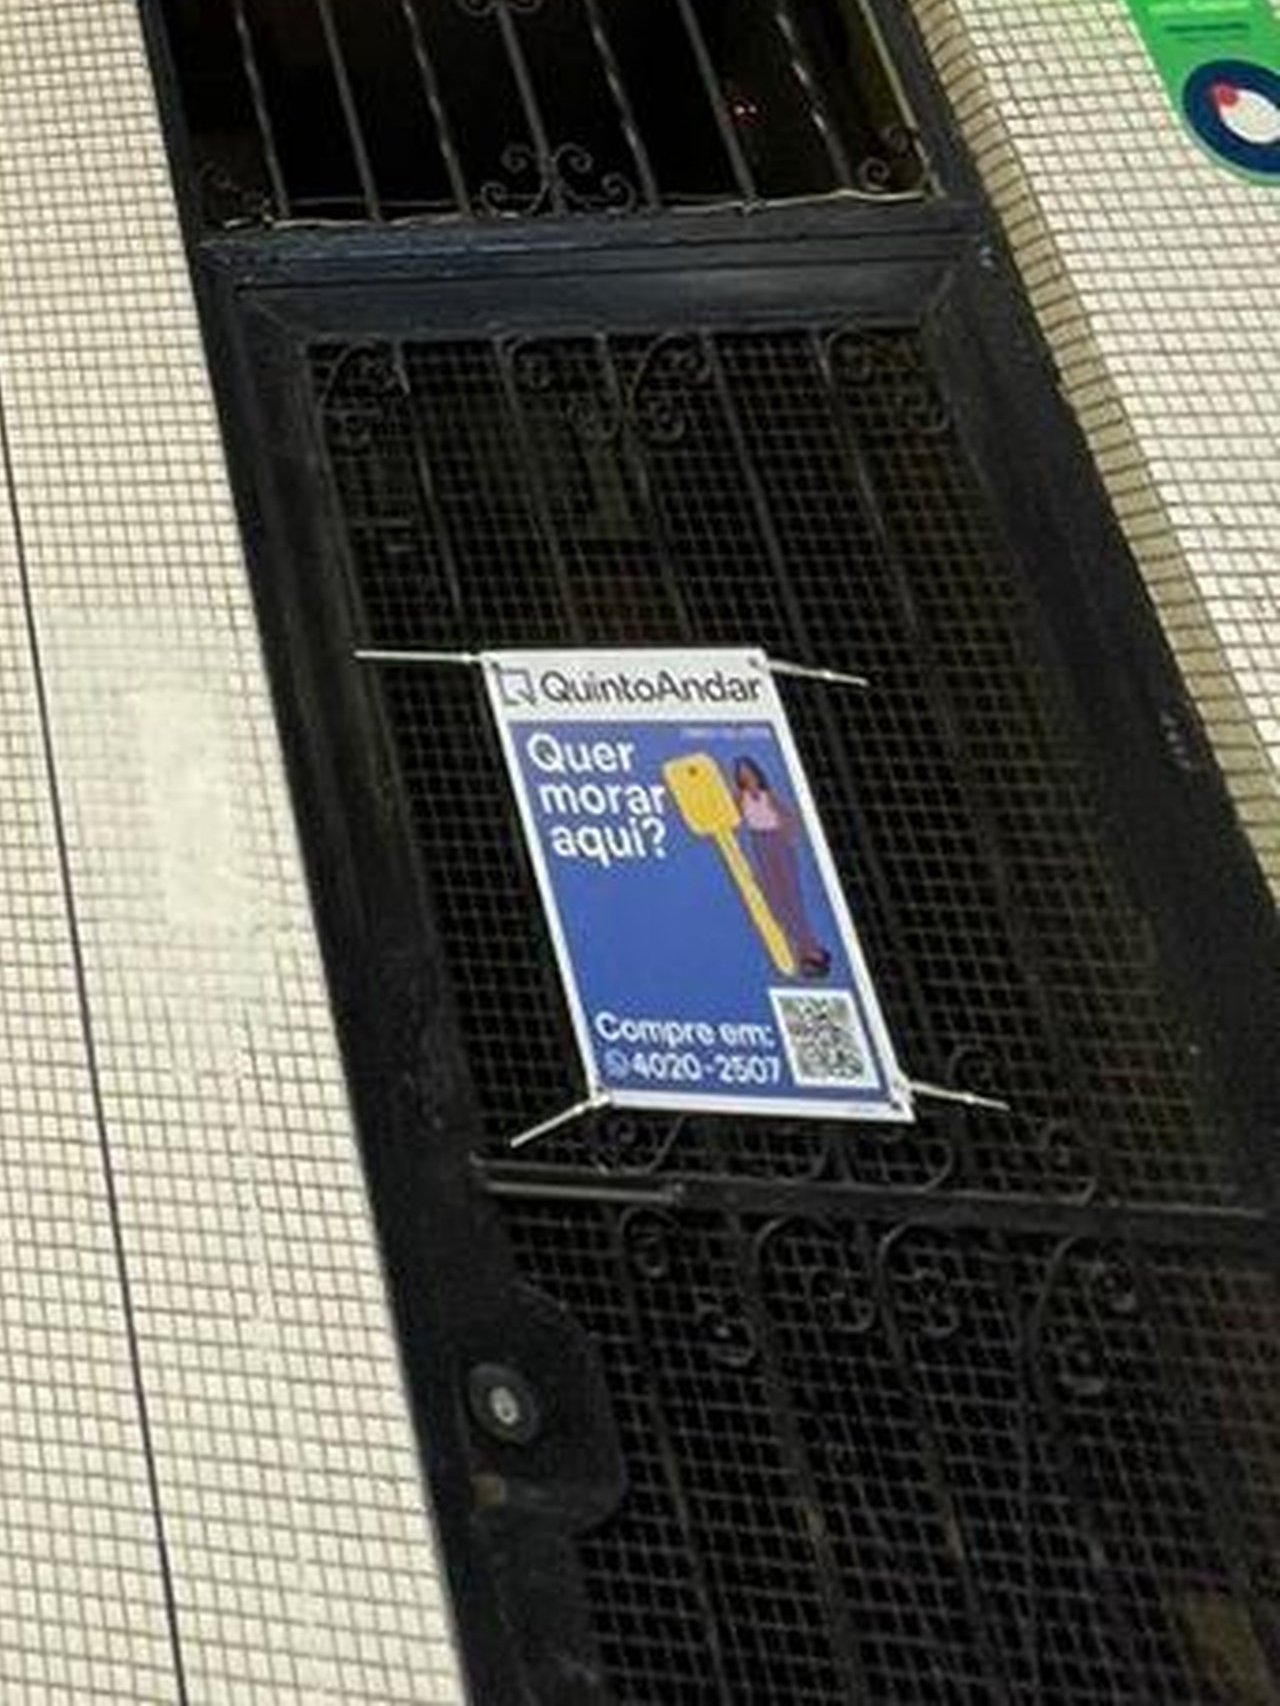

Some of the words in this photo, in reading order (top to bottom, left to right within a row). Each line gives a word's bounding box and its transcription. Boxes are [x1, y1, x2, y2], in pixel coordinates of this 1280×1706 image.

[539, 669, 763, 703] QuintoAndar
[526, 732, 635, 775] Quer
[539, 783, 666, 816] morar
[550, 817, 667, 868] aqui?
[593, 1010, 715, 1047] Compre
[630, 1051, 781, 1084] 4020-2507
